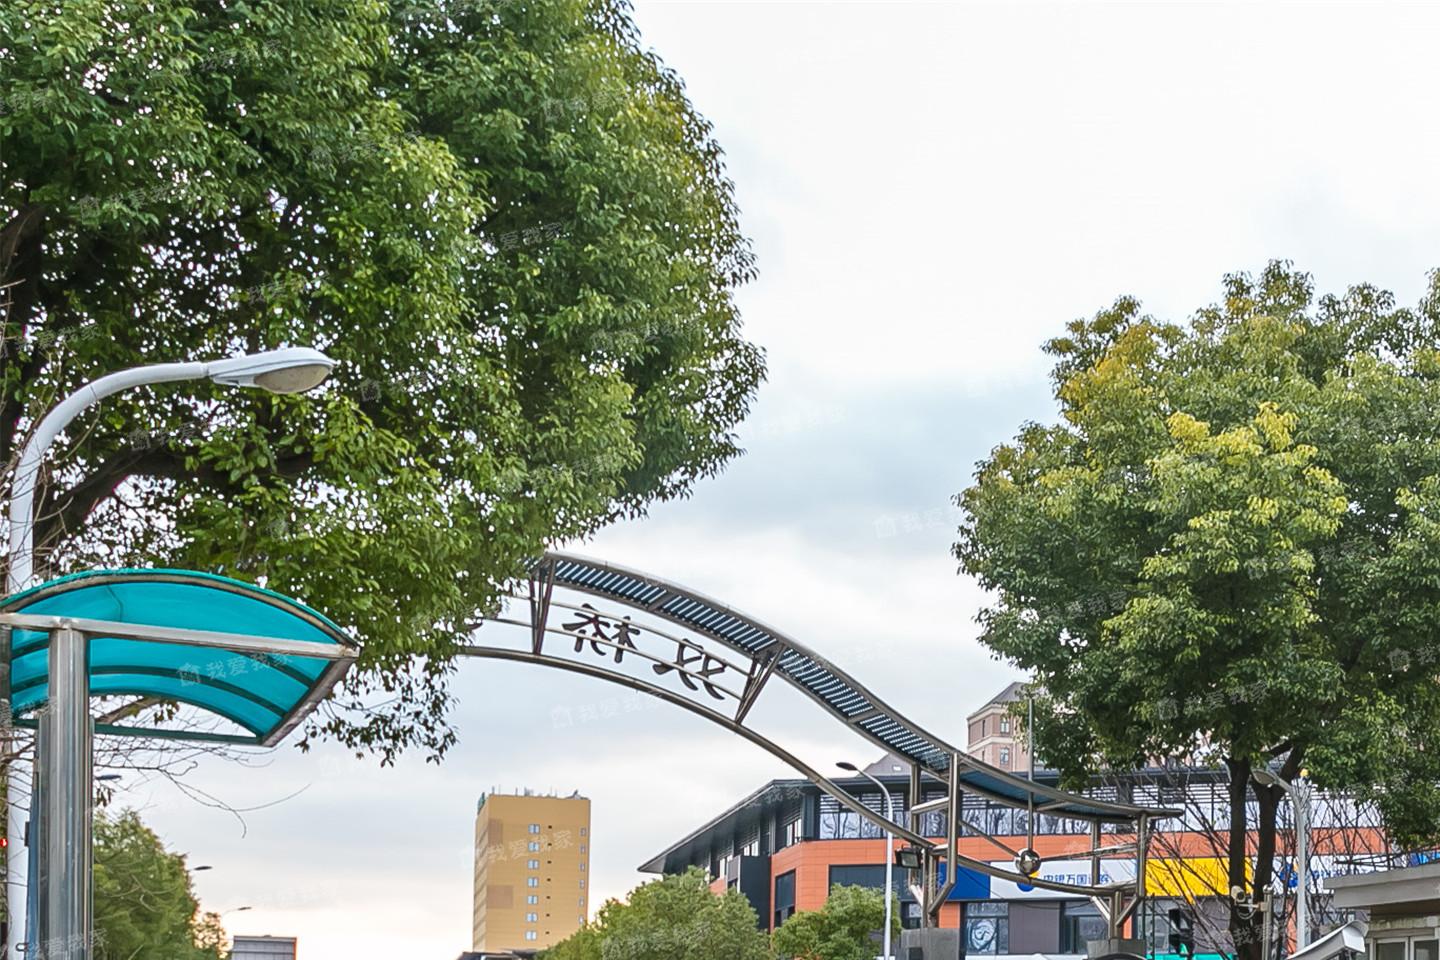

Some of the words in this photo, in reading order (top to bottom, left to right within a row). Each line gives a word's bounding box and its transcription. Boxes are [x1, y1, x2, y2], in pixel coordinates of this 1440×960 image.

[1043, 874, 1109, 885] 申银万国券
